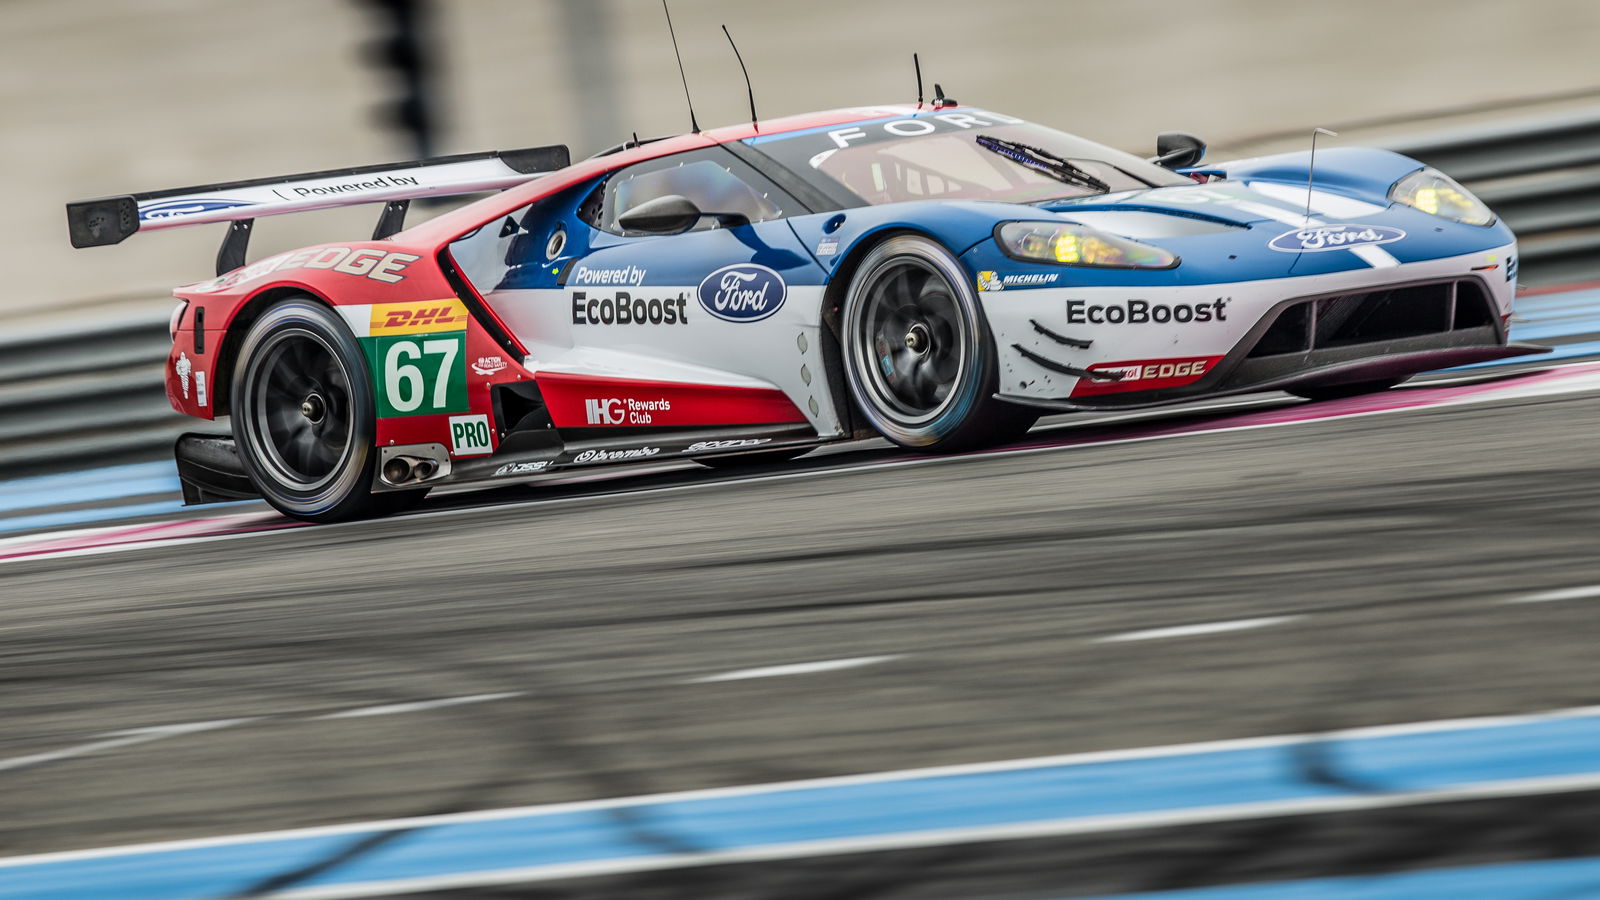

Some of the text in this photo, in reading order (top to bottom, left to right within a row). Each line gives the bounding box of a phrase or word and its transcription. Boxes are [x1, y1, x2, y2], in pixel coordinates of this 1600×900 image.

[293, 174, 419, 198] Powered by
[1296, 227, 1384, 248] Ford
[276, 247, 421, 284] EDGE
[575, 265, 646, 286] Powered by
[1003, 273, 1060, 284] MICHELIN
[714, 270, 770, 312] Ford
[384, 306, 456, 328] DHL
[572, 291, 688, 325] EcoBoost
[1066, 297, 1231, 324] EcoBoost
[384, 338, 459, 412] 67
[1142, 360, 1208, 380] EDGE
[628, 398, 671, 411] Rewards
[629, 411, 652, 424] Club
[453, 421, 489, 449] PRO
